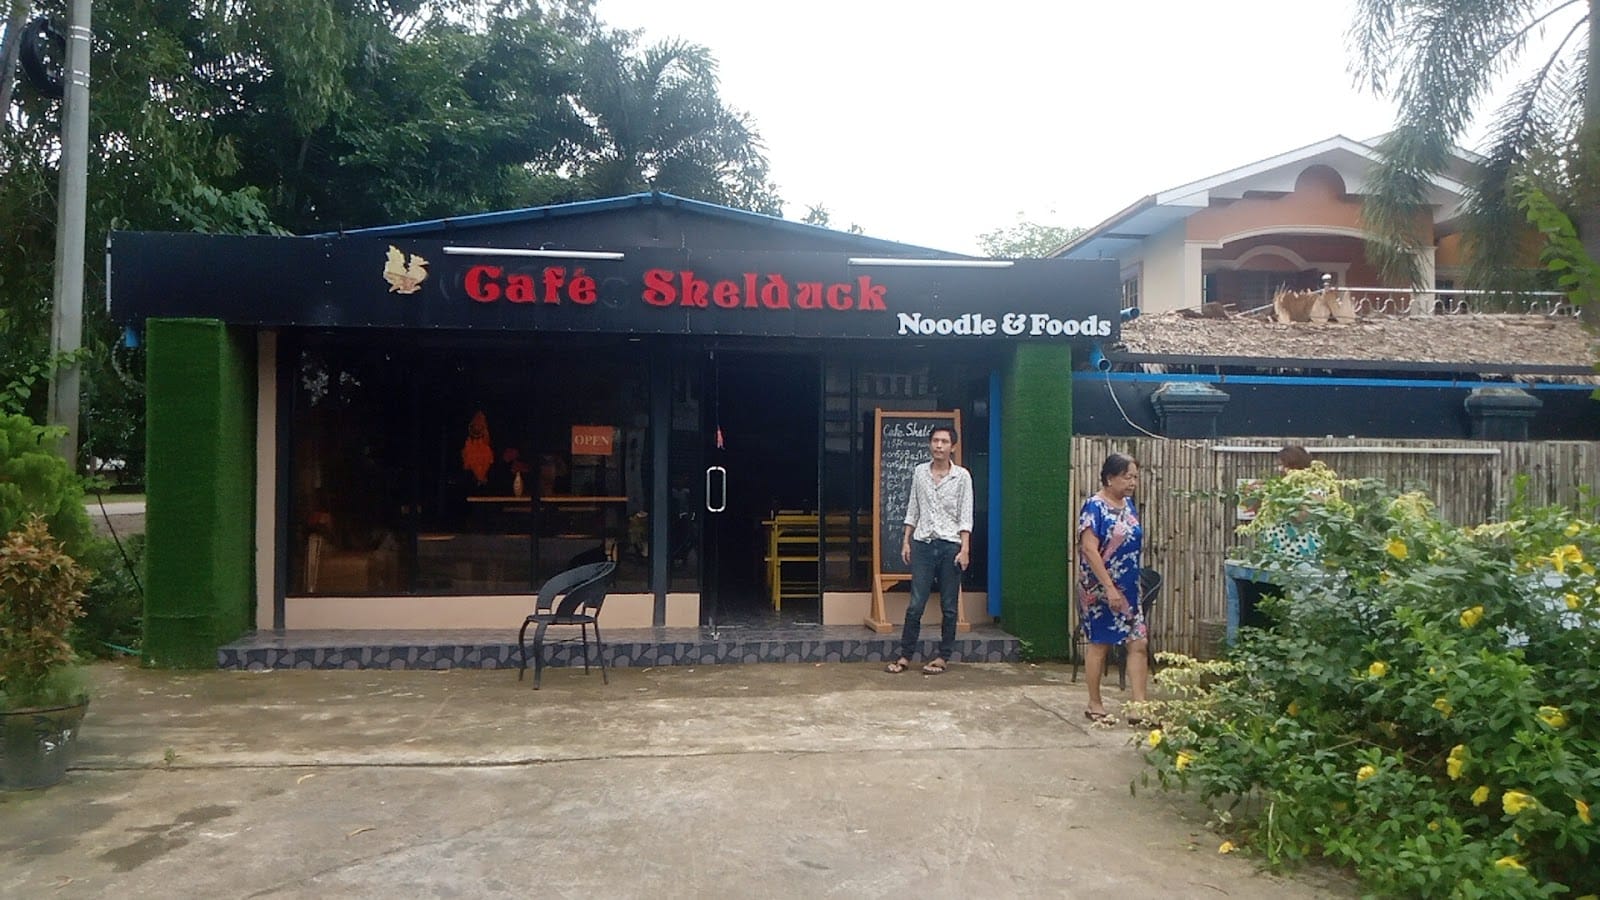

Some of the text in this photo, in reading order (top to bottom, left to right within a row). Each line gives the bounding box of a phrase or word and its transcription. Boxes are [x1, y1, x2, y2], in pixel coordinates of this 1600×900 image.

[642, 268, 887, 311] Shelduck
[897, 312, 1112, 337] Noodle & Foods
[574, 435, 609, 446] OPEN
